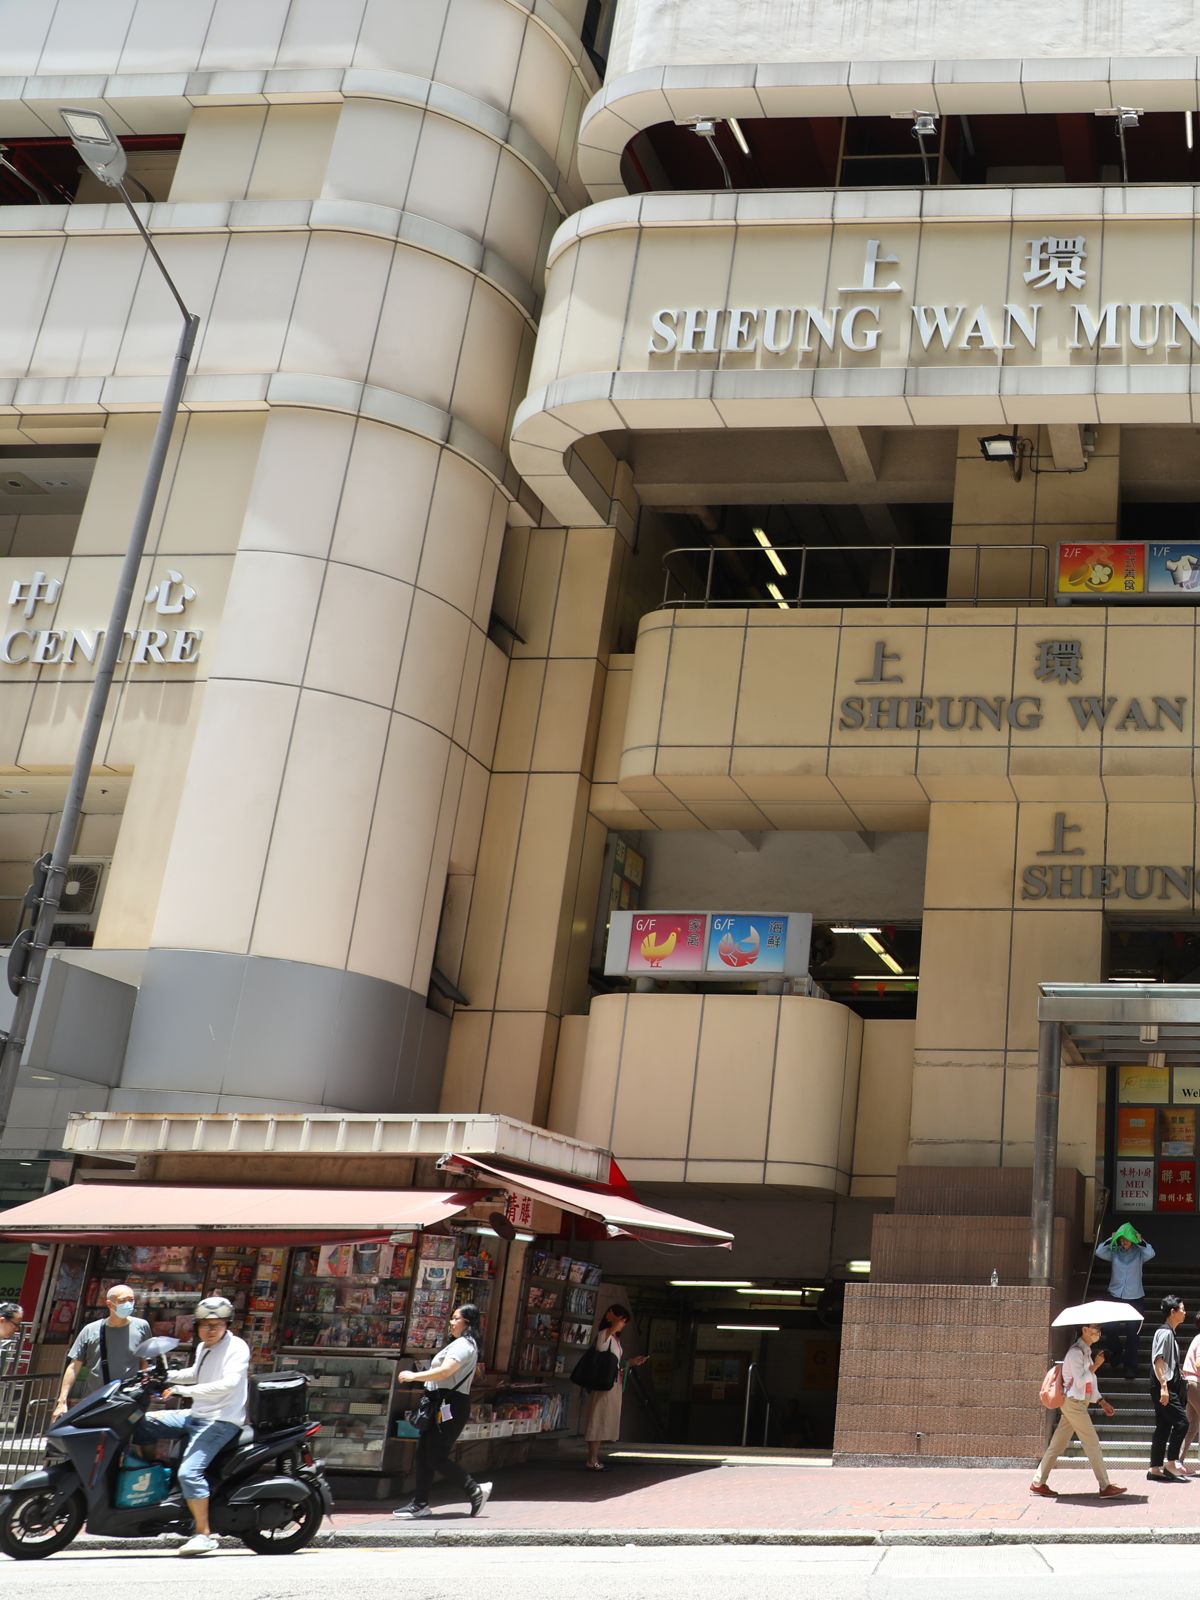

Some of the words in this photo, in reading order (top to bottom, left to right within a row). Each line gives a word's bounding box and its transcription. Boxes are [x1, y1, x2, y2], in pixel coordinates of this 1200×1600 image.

[648, 305, 881, 354] SHEUNG
[912, 304, 1041, 351] WAN
[1152, 546, 1170, 557] 1/F
[8, 569, 197, 619] 中心
[839, 696, 1044, 732] SHEUNG
[1068, 697, 1188, 732] WAN
[635, 918, 657, 932] G/F
[714, 918, 736, 931] G/F
[767, 920, 784, 948] 海鮮
[1125, 1180, 1145, 1189] MEI
[1120, 1190, 1149, 1198] HEEN
